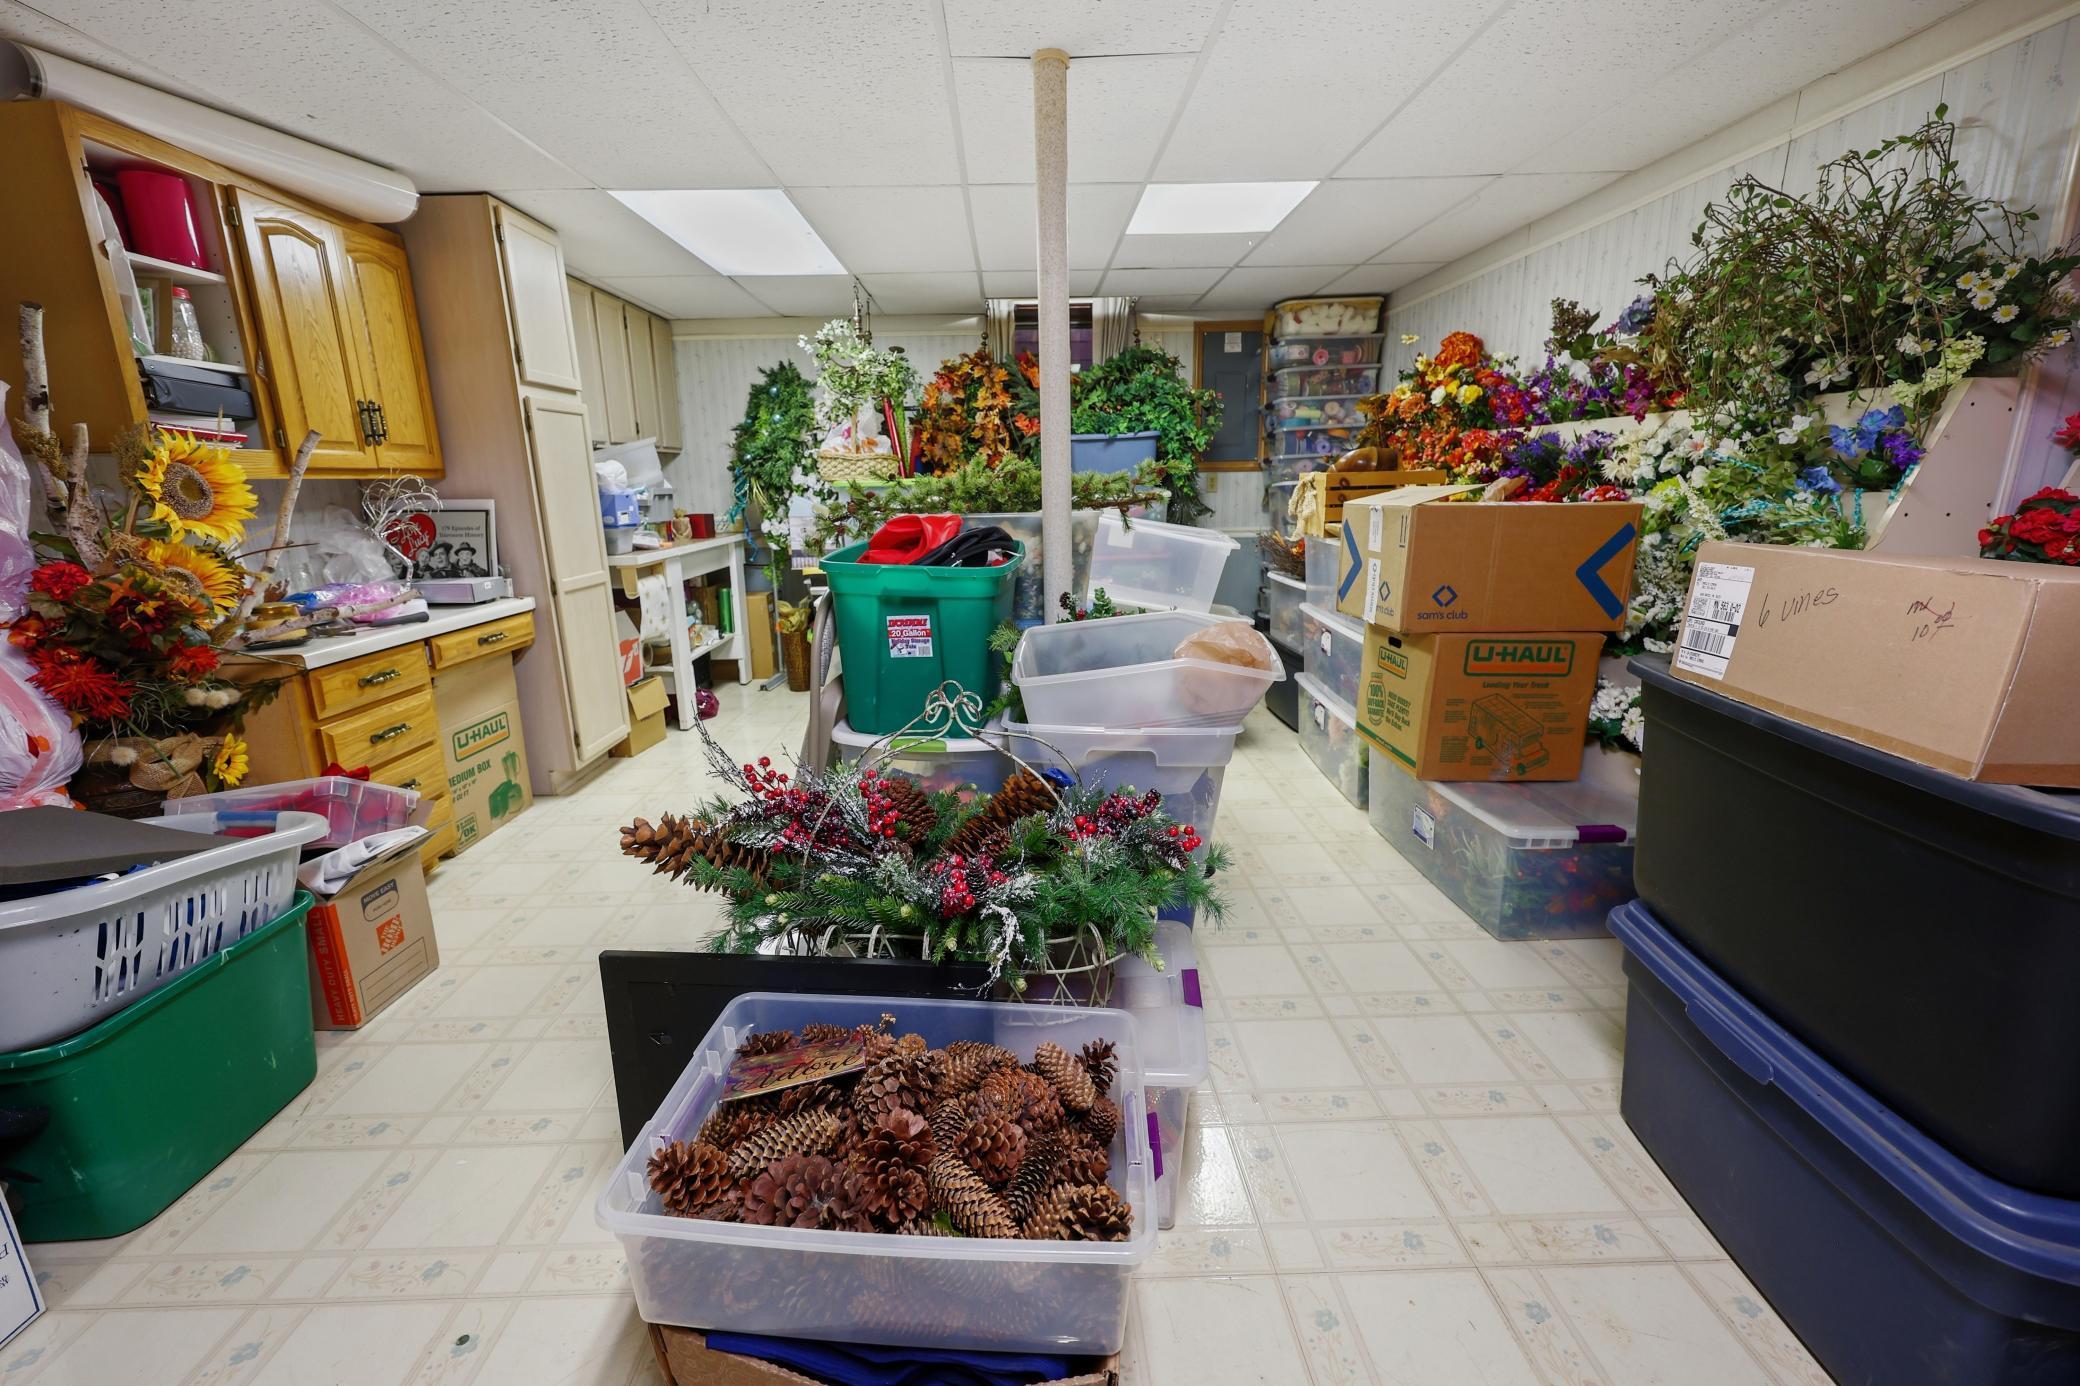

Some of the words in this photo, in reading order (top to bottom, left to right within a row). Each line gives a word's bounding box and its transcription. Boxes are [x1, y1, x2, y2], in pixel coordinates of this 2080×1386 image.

[407, 530, 430, 557] Lucy
[1780, 586, 1840, 622] vines
[1416, 610, 1444, 620] sam's
[1446, 610, 1468, 620] club
[902, 629, 927, 637] Gallon
[1380, 649, 1407, 670] U-HAUL
[1472, 646, 1567, 663] U-HAUL
[457, 717, 507, 749] U-HAUL
[477, 758, 492, 774] BOX
[464, 825, 476, 838] OK
[380, 881, 395, 895] EASY
